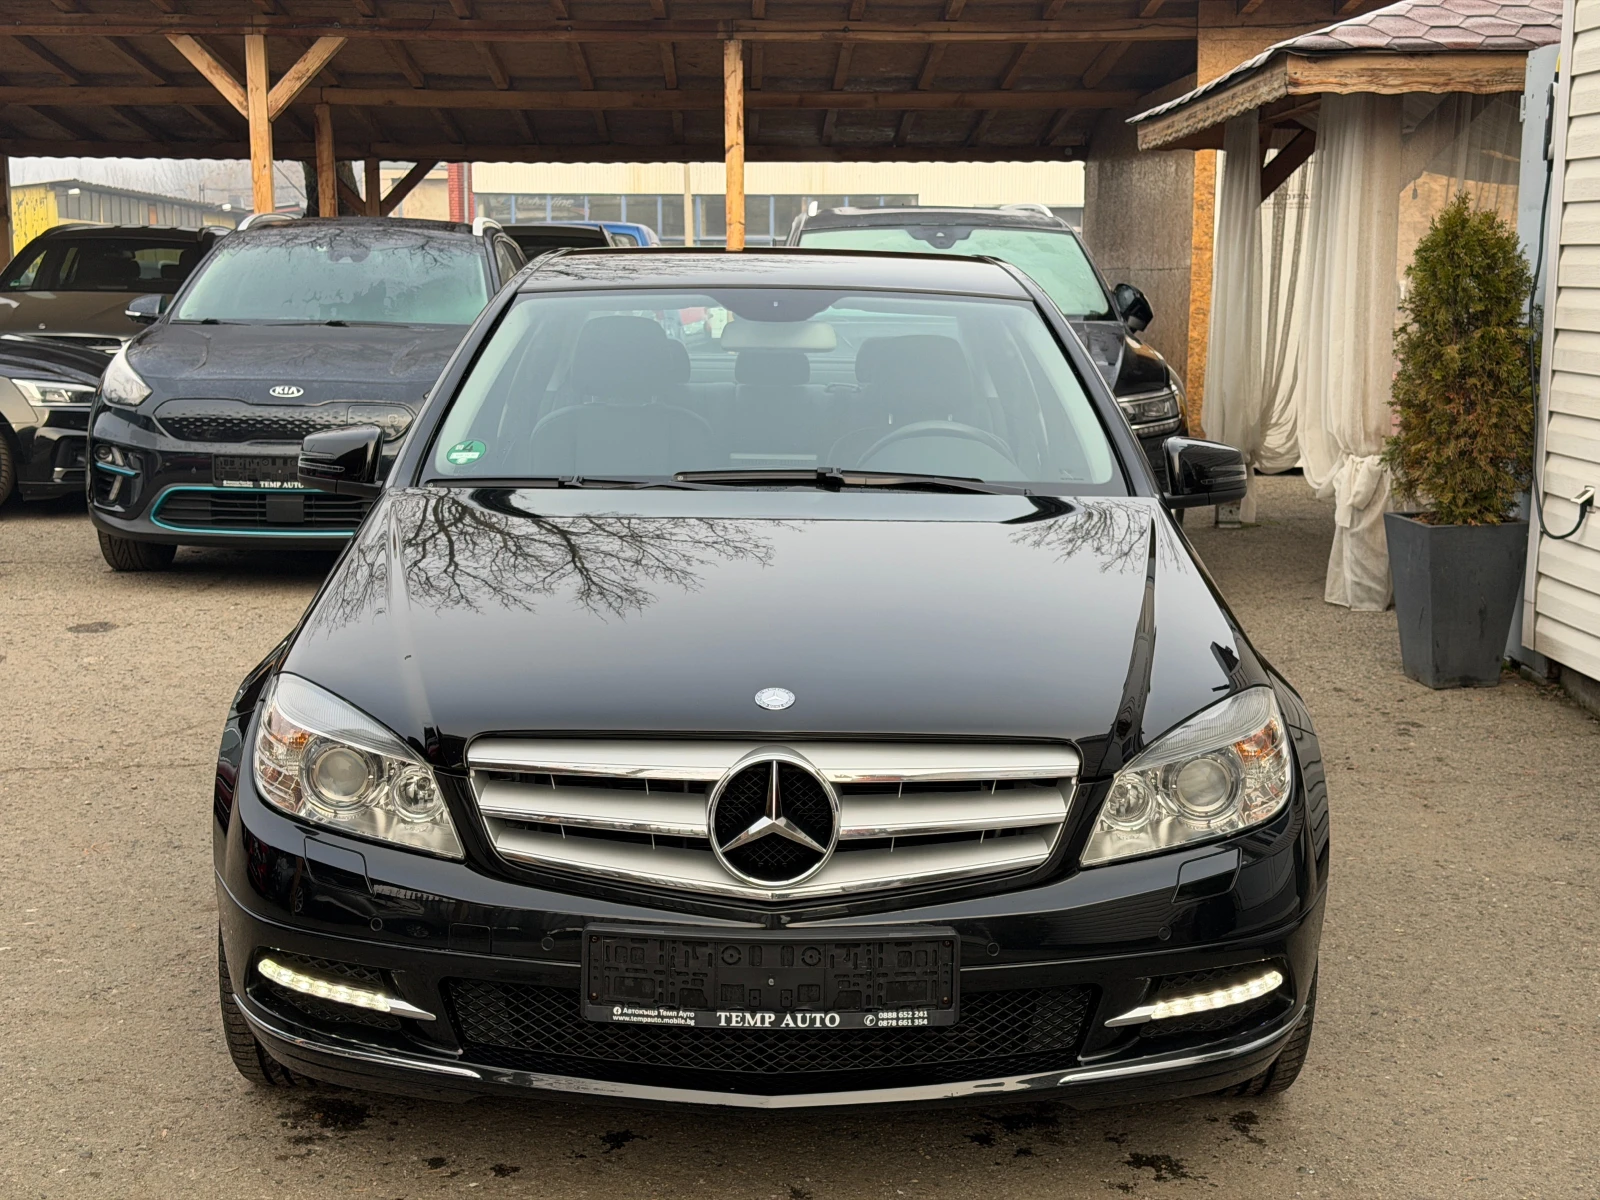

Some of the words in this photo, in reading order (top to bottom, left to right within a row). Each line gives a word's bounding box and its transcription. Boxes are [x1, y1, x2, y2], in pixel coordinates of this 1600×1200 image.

[275, 386, 298, 394] KIA
[623, 1007, 658, 1016] Автокъща
[659, 1009, 677, 1017] Темп
[612, 1015, 695, 1026] www.tempauto.mobile.bg
[716, 1012, 775, 1027] TEMP
[780, 1013, 840, 1027] AUTO
